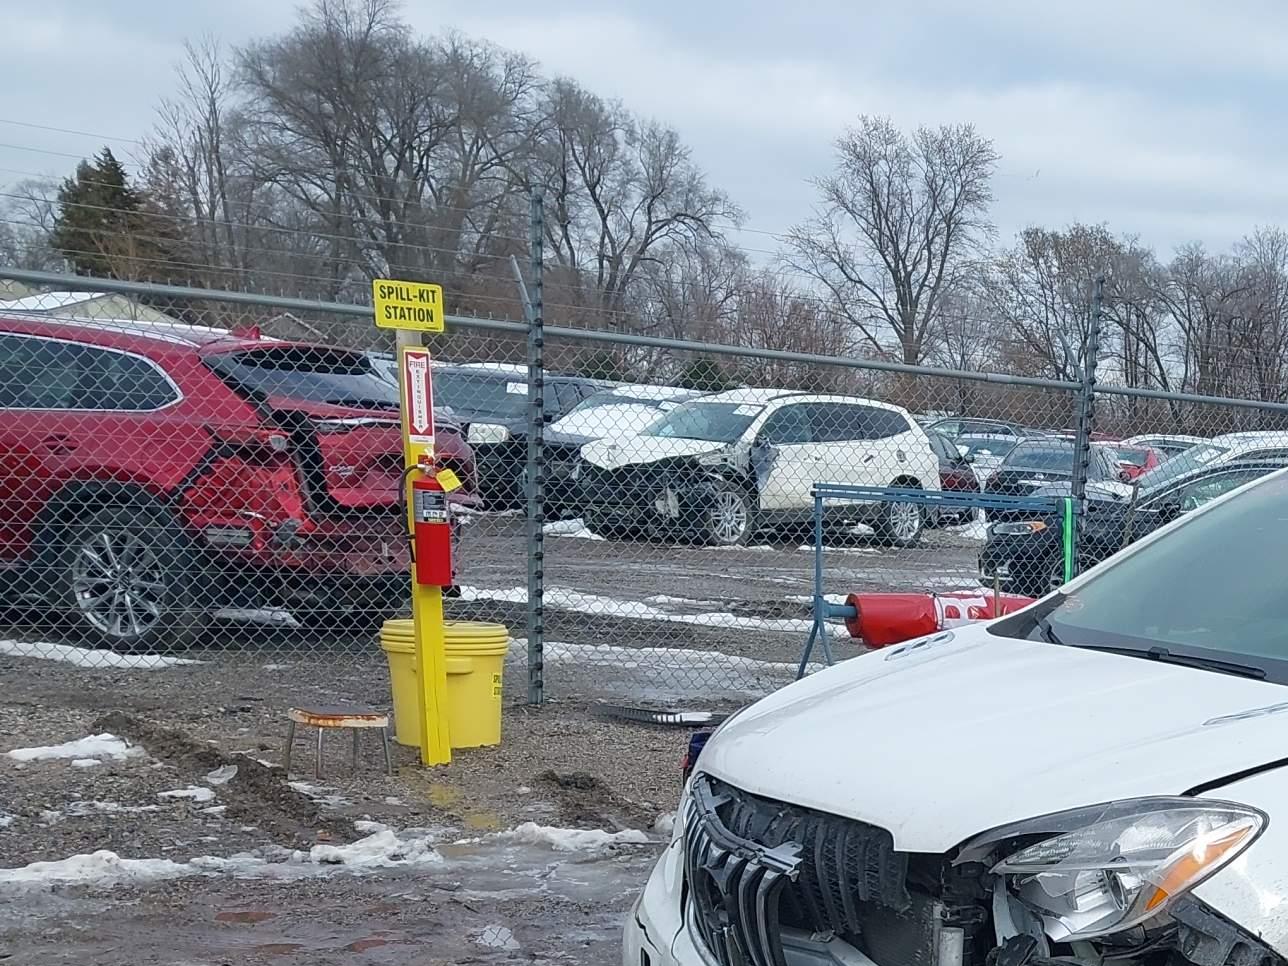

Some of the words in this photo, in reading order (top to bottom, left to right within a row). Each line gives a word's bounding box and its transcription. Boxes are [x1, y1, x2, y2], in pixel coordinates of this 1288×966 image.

[379, 284, 437, 304] SPILL-KIT
[384, 305, 434, 323] STATION
[409, 360, 425, 369] FIRE
[415, 369, 423, 429] EXTINGUISHER
